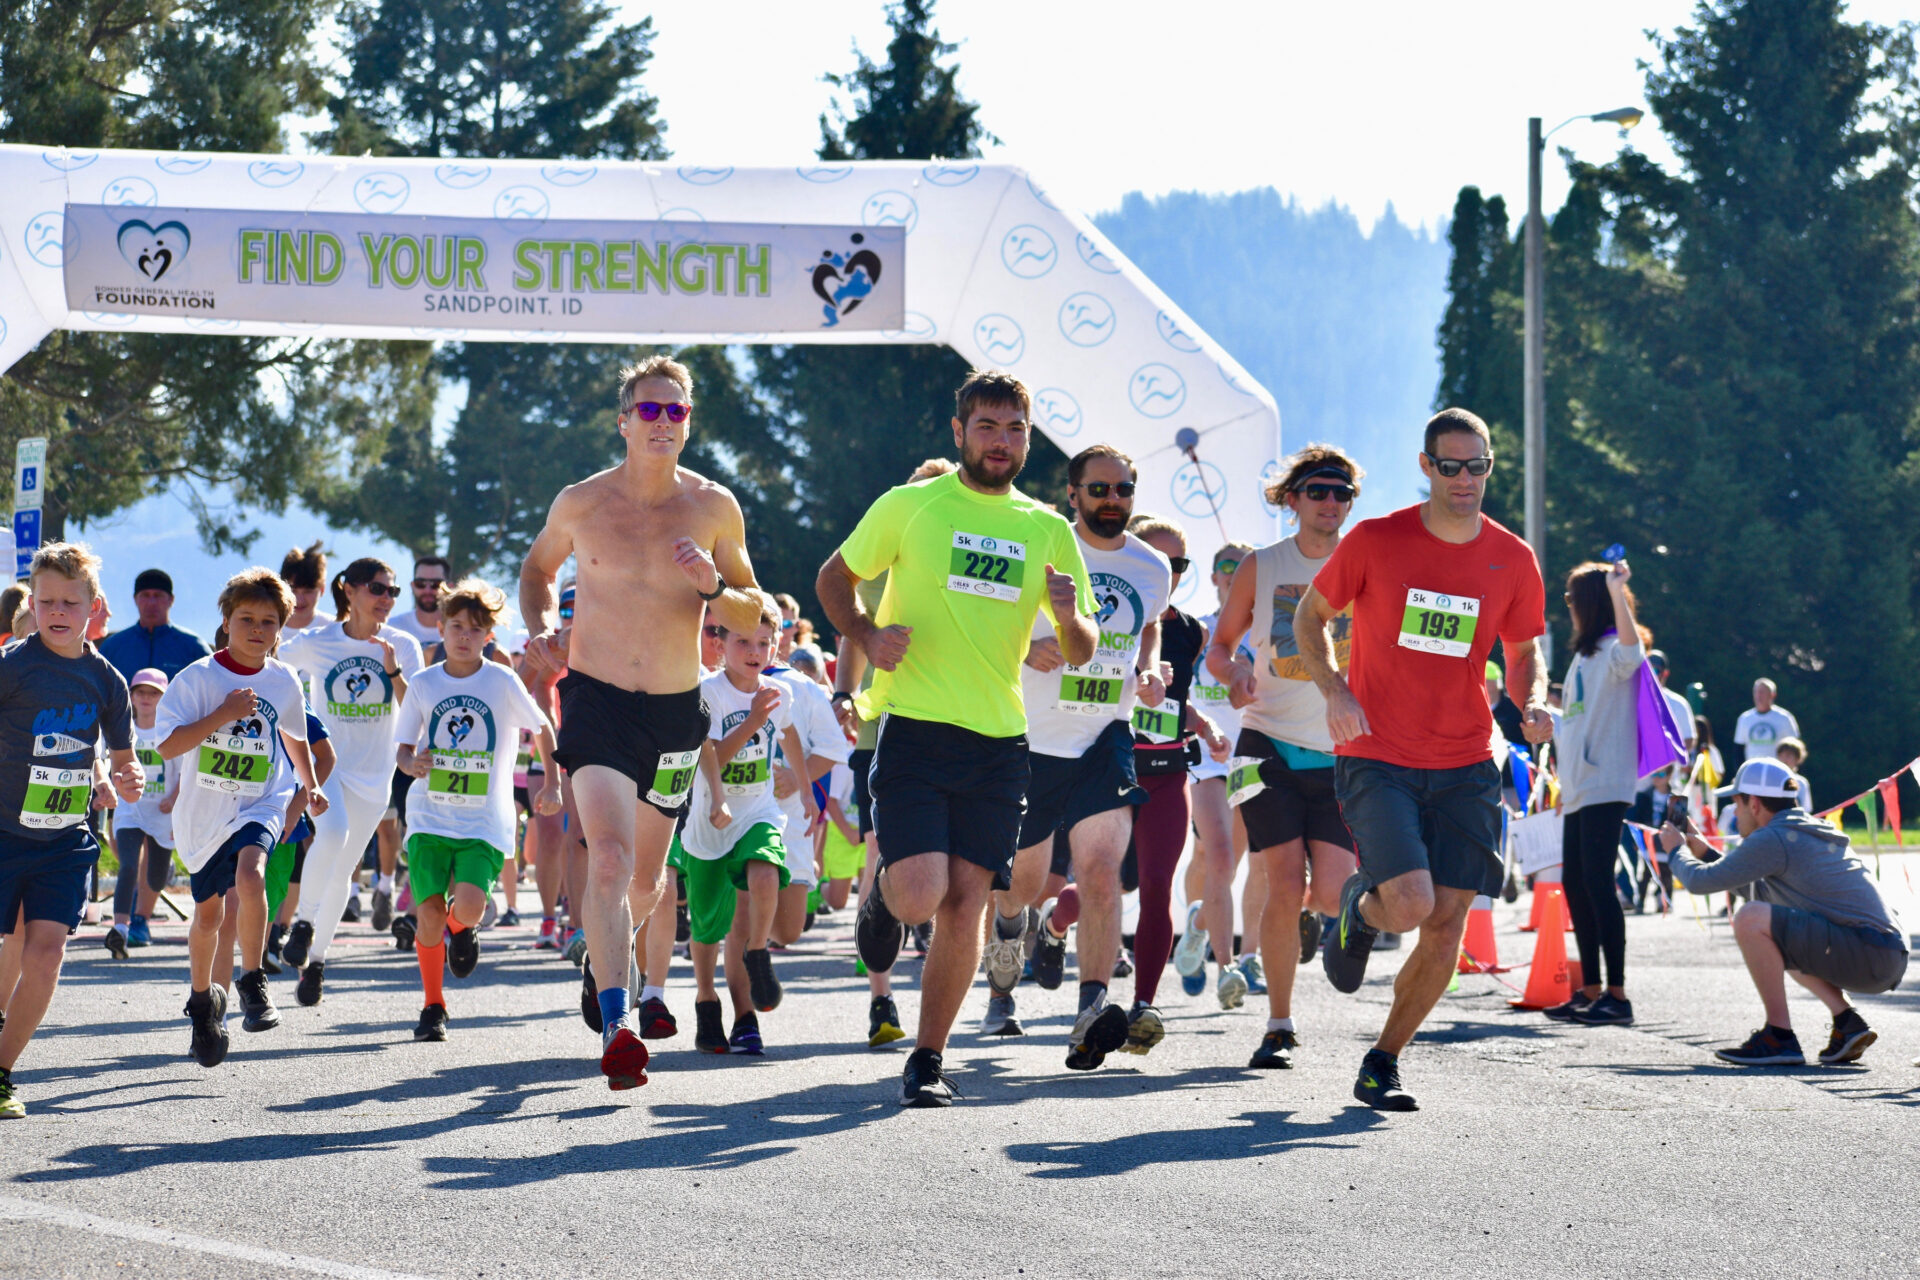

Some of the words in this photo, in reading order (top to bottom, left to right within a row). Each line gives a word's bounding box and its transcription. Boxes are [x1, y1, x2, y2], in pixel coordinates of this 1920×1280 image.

[239, 229, 345, 286] FIND
[358, 233, 488, 292] YOUR
[513, 239, 771, 297] STRENGTH
[96, 292, 216, 309] FOUNDATION
[562, 300, 583, 315] ID
[958, 536, 971, 546] 5k
[1008, 545, 1020, 555] 1k
[964, 552, 1010, 583] 222
[1105, 577, 1134, 597] YOUR
[1413, 593, 1426, 603] 5k
[1462, 602, 1474, 611] 1k
[1419, 611, 1460, 639] 193
[335, 659, 357, 673] FIND
[360, 659, 384, 675] YOUR
[1112, 667, 1122, 676] 1k
[1075, 679, 1110, 703] 148
[327, 700, 391, 718] STRENGTH
[434, 698, 457, 716] FIND
[461, 697, 488, 716] YOUR
[1165, 702, 1175, 711] 1k
[724, 713, 745, 728] FIND
[1136, 709, 1162, 734] 171
[254, 742, 264, 751] 1k
[210, 751, 254, 781] 242
[435, 758, 446, 767] 5k
[476, 762, 486, 770] 1k
[662, 757, 673, 766] 5k
[35, 771, 49, 780] 5k
[670, 768, 692, 794] 69
[721, 762, 757, 784] 253
[447, 772, 469, 794] 21
[44, 788, 73, 814] 46
